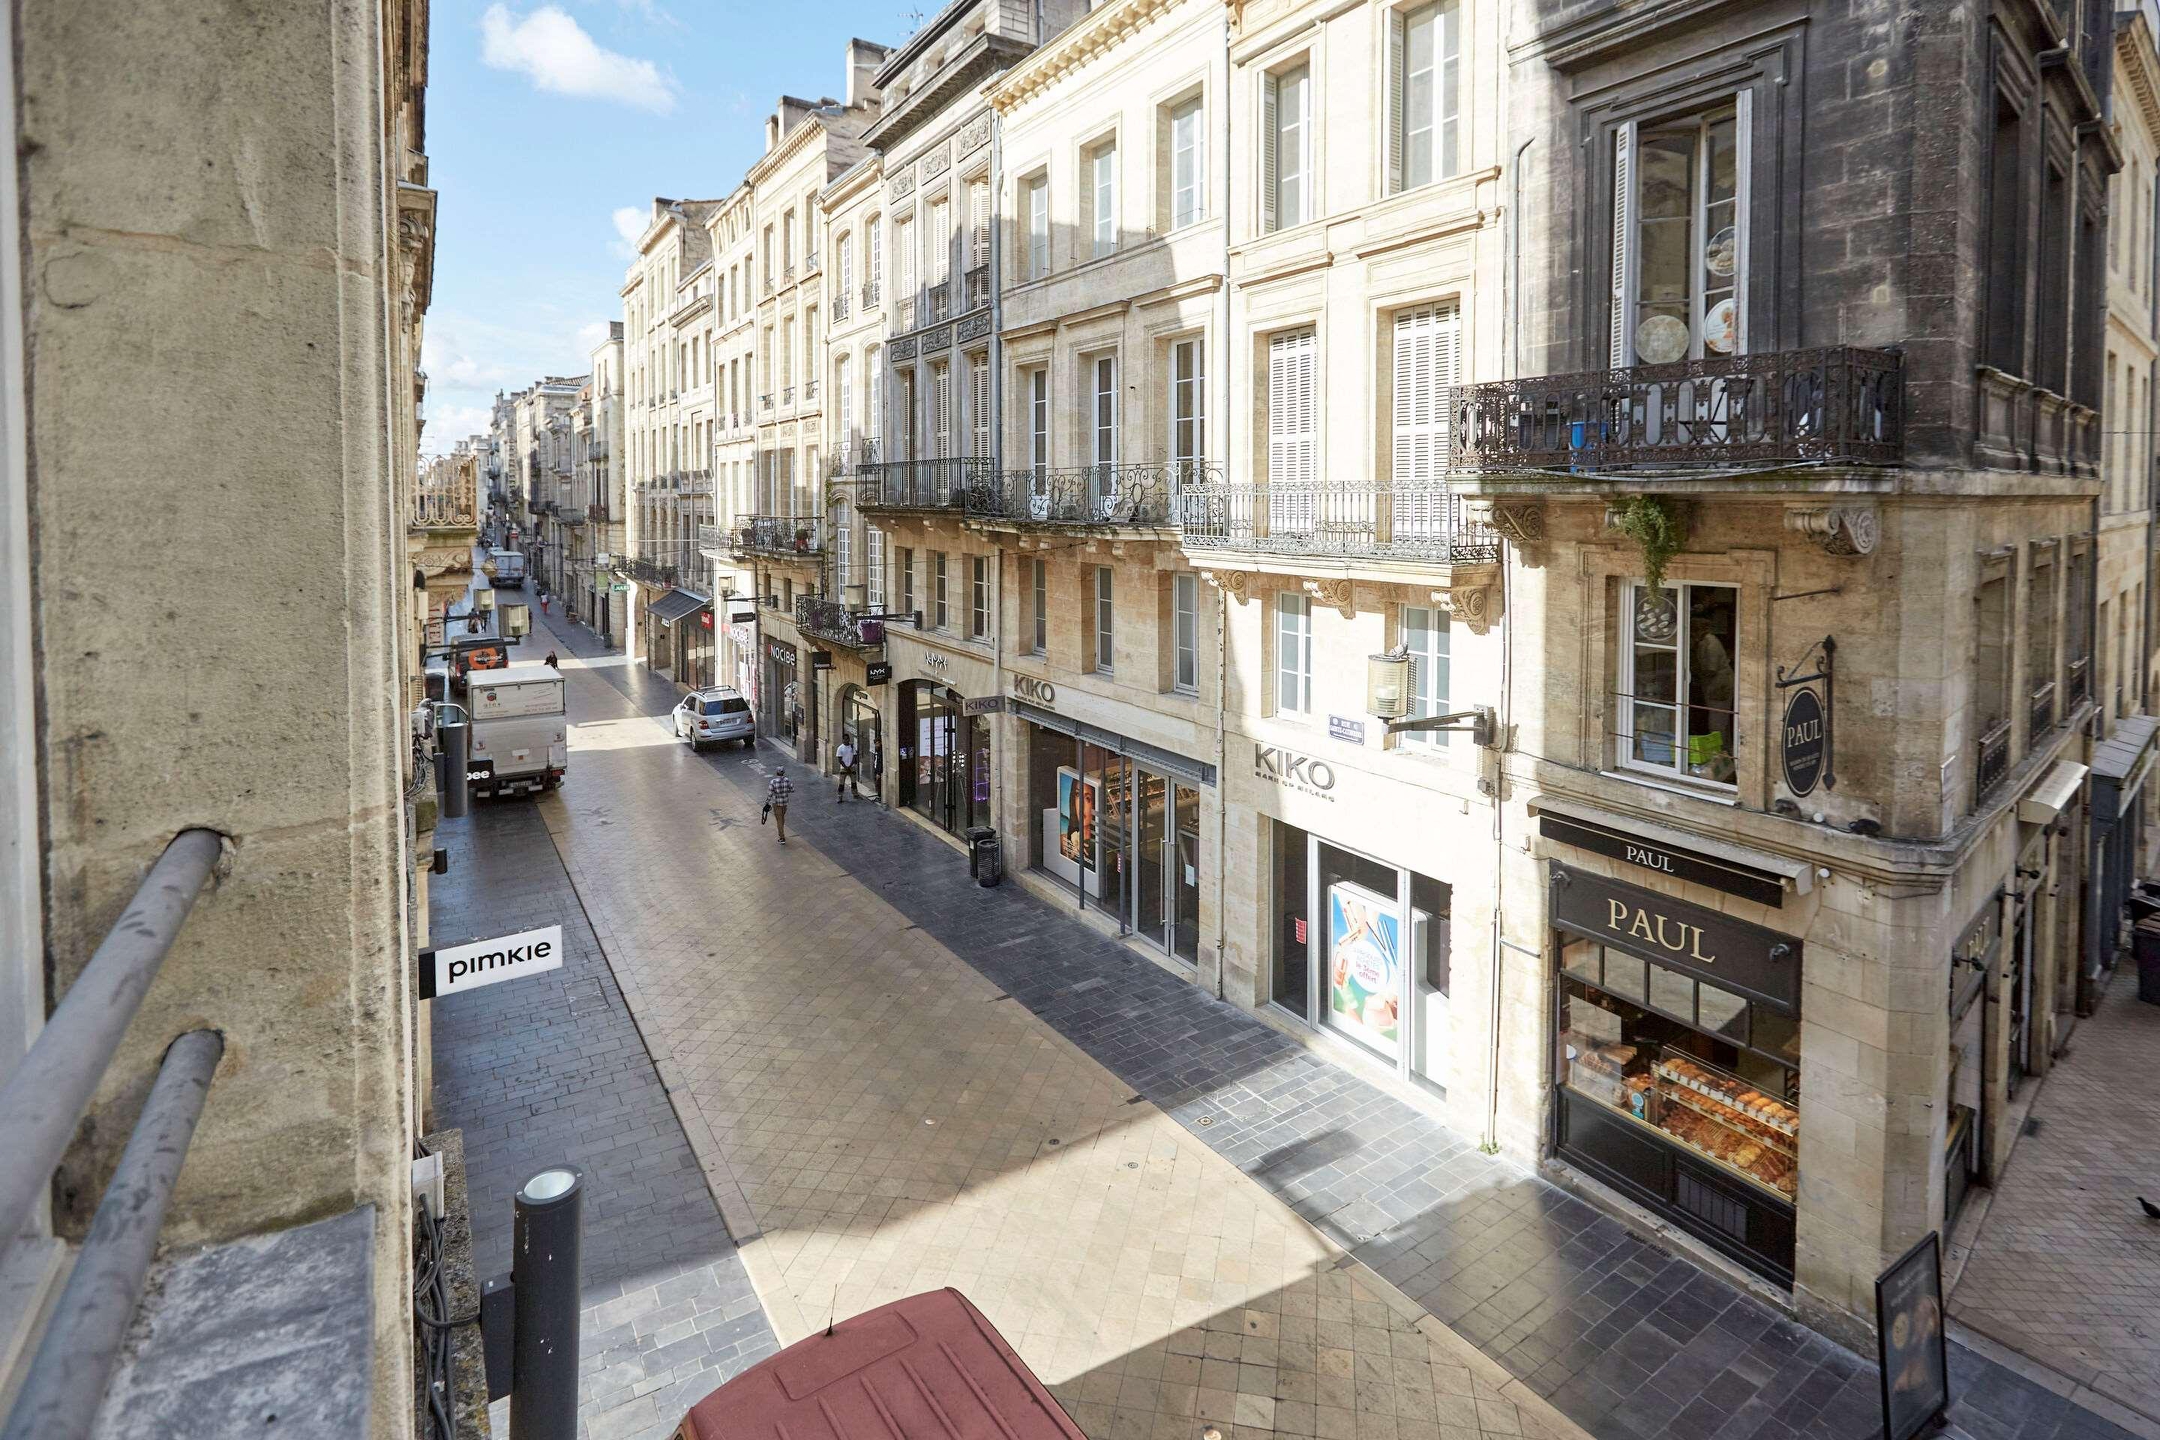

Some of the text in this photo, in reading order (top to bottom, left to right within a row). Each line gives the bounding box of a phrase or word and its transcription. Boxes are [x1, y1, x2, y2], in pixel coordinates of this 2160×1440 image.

[869, 667, 885, 676] NYX
[925, 650, 948, 671] NYX
[1013, 674, 1056, 703] KIKO
[965, 699, 998, 711] KIKO
[1787, 719, 1822, 748] PAUL
[1255, 743, 1335, 790] KIKO
[1626, 845, 1674, 873] PAUL
[1607, 898, 1716, 963] PAUL
[449, 941, 552, 984] pimkie
